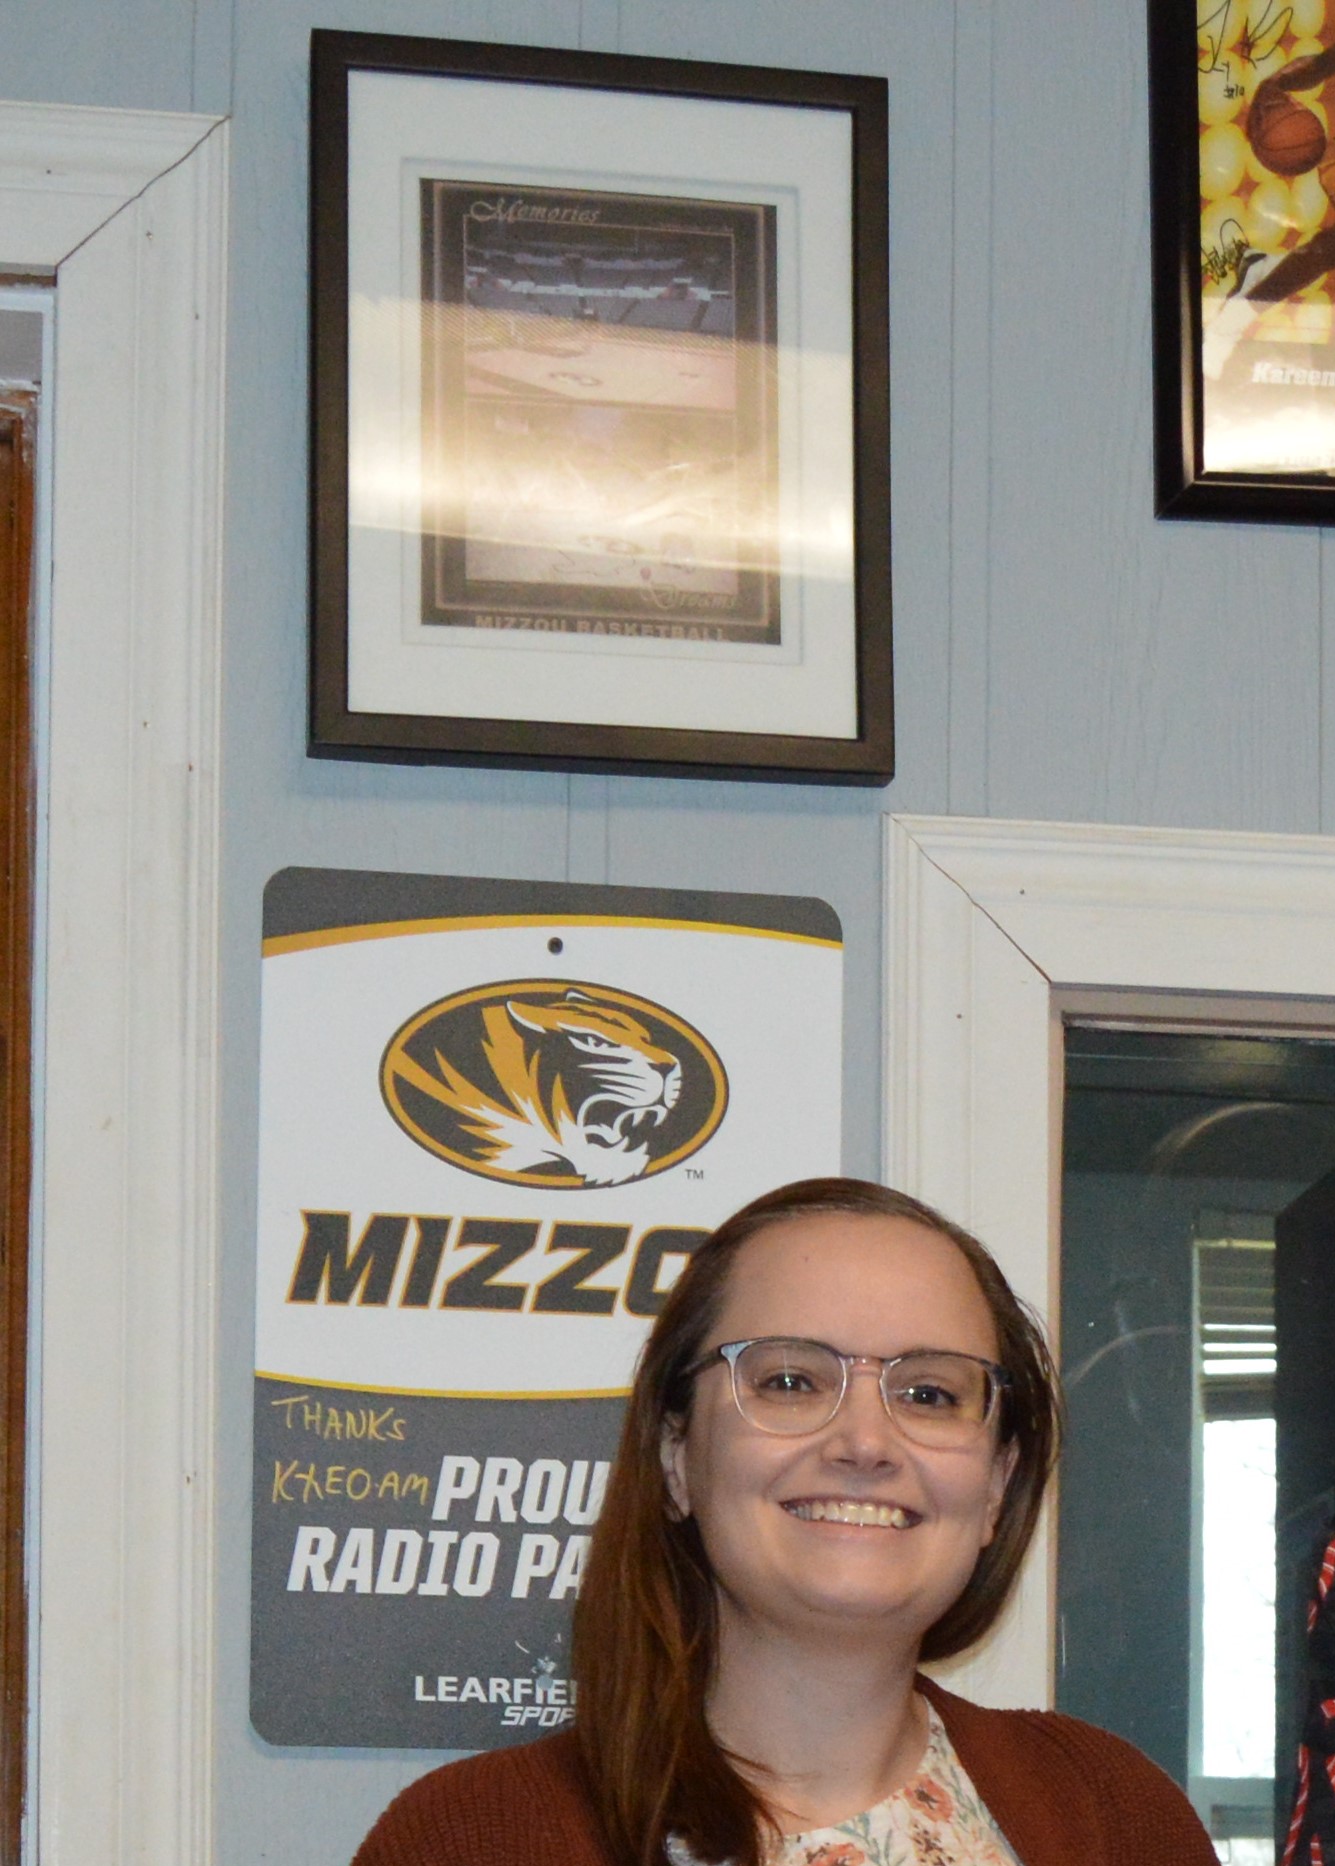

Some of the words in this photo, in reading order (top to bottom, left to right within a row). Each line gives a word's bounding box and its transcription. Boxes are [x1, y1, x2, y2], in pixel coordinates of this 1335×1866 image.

[684, 1168, 705, 1181] TM
[284, 1208, 714, 1318] MIZZO
[271, 1395, 407, 1441] THANKS
[431, 1455, 614, 1526] PROU
[286, 1525, 500, 1598] RADIO
[510, 1533, 594, 1600] PA
[414, 1675, 578, 1705] LEARFIE
